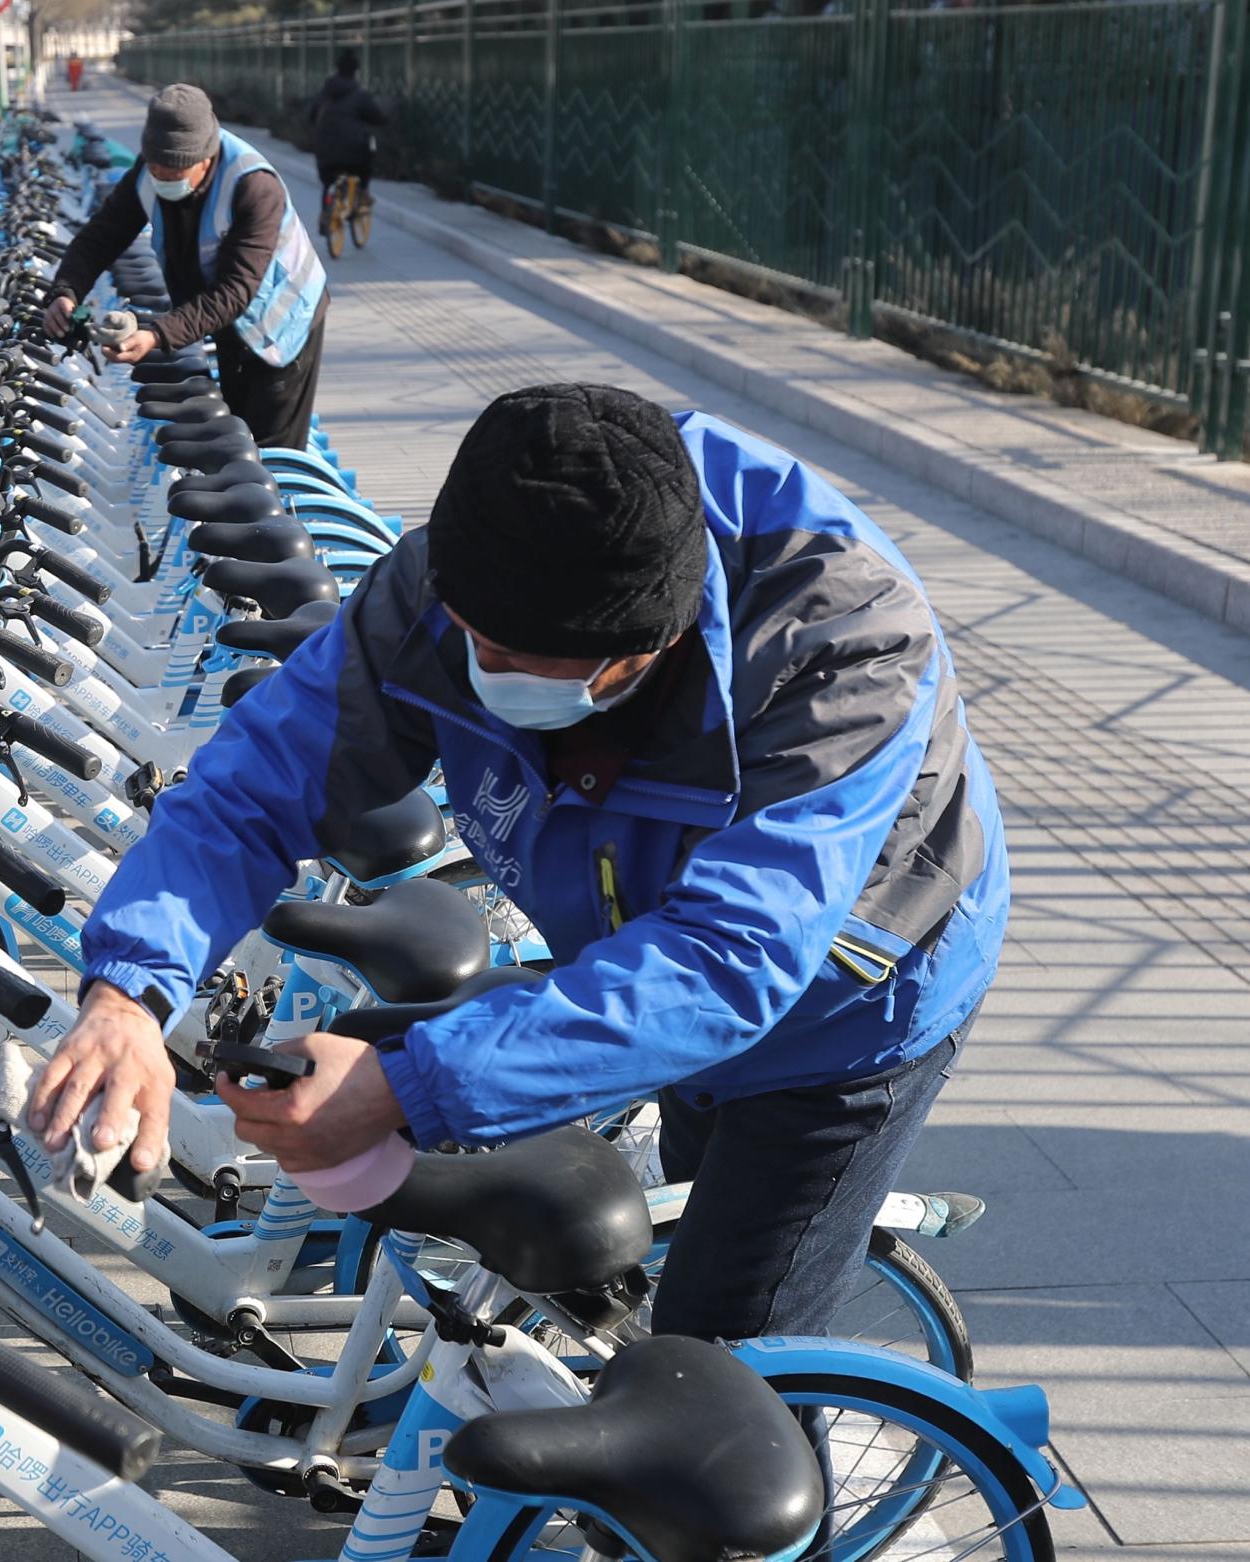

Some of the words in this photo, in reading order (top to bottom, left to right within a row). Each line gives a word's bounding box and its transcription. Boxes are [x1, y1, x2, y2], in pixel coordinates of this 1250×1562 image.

[193, 615, 208, 634] P
[293, 992, 317, 1021] P
[85, 1191, 176, 1262] 骑车更优惠
[40, 1287, 138, 1366] Hellobike
[418, 1428, 453, 1473] P
